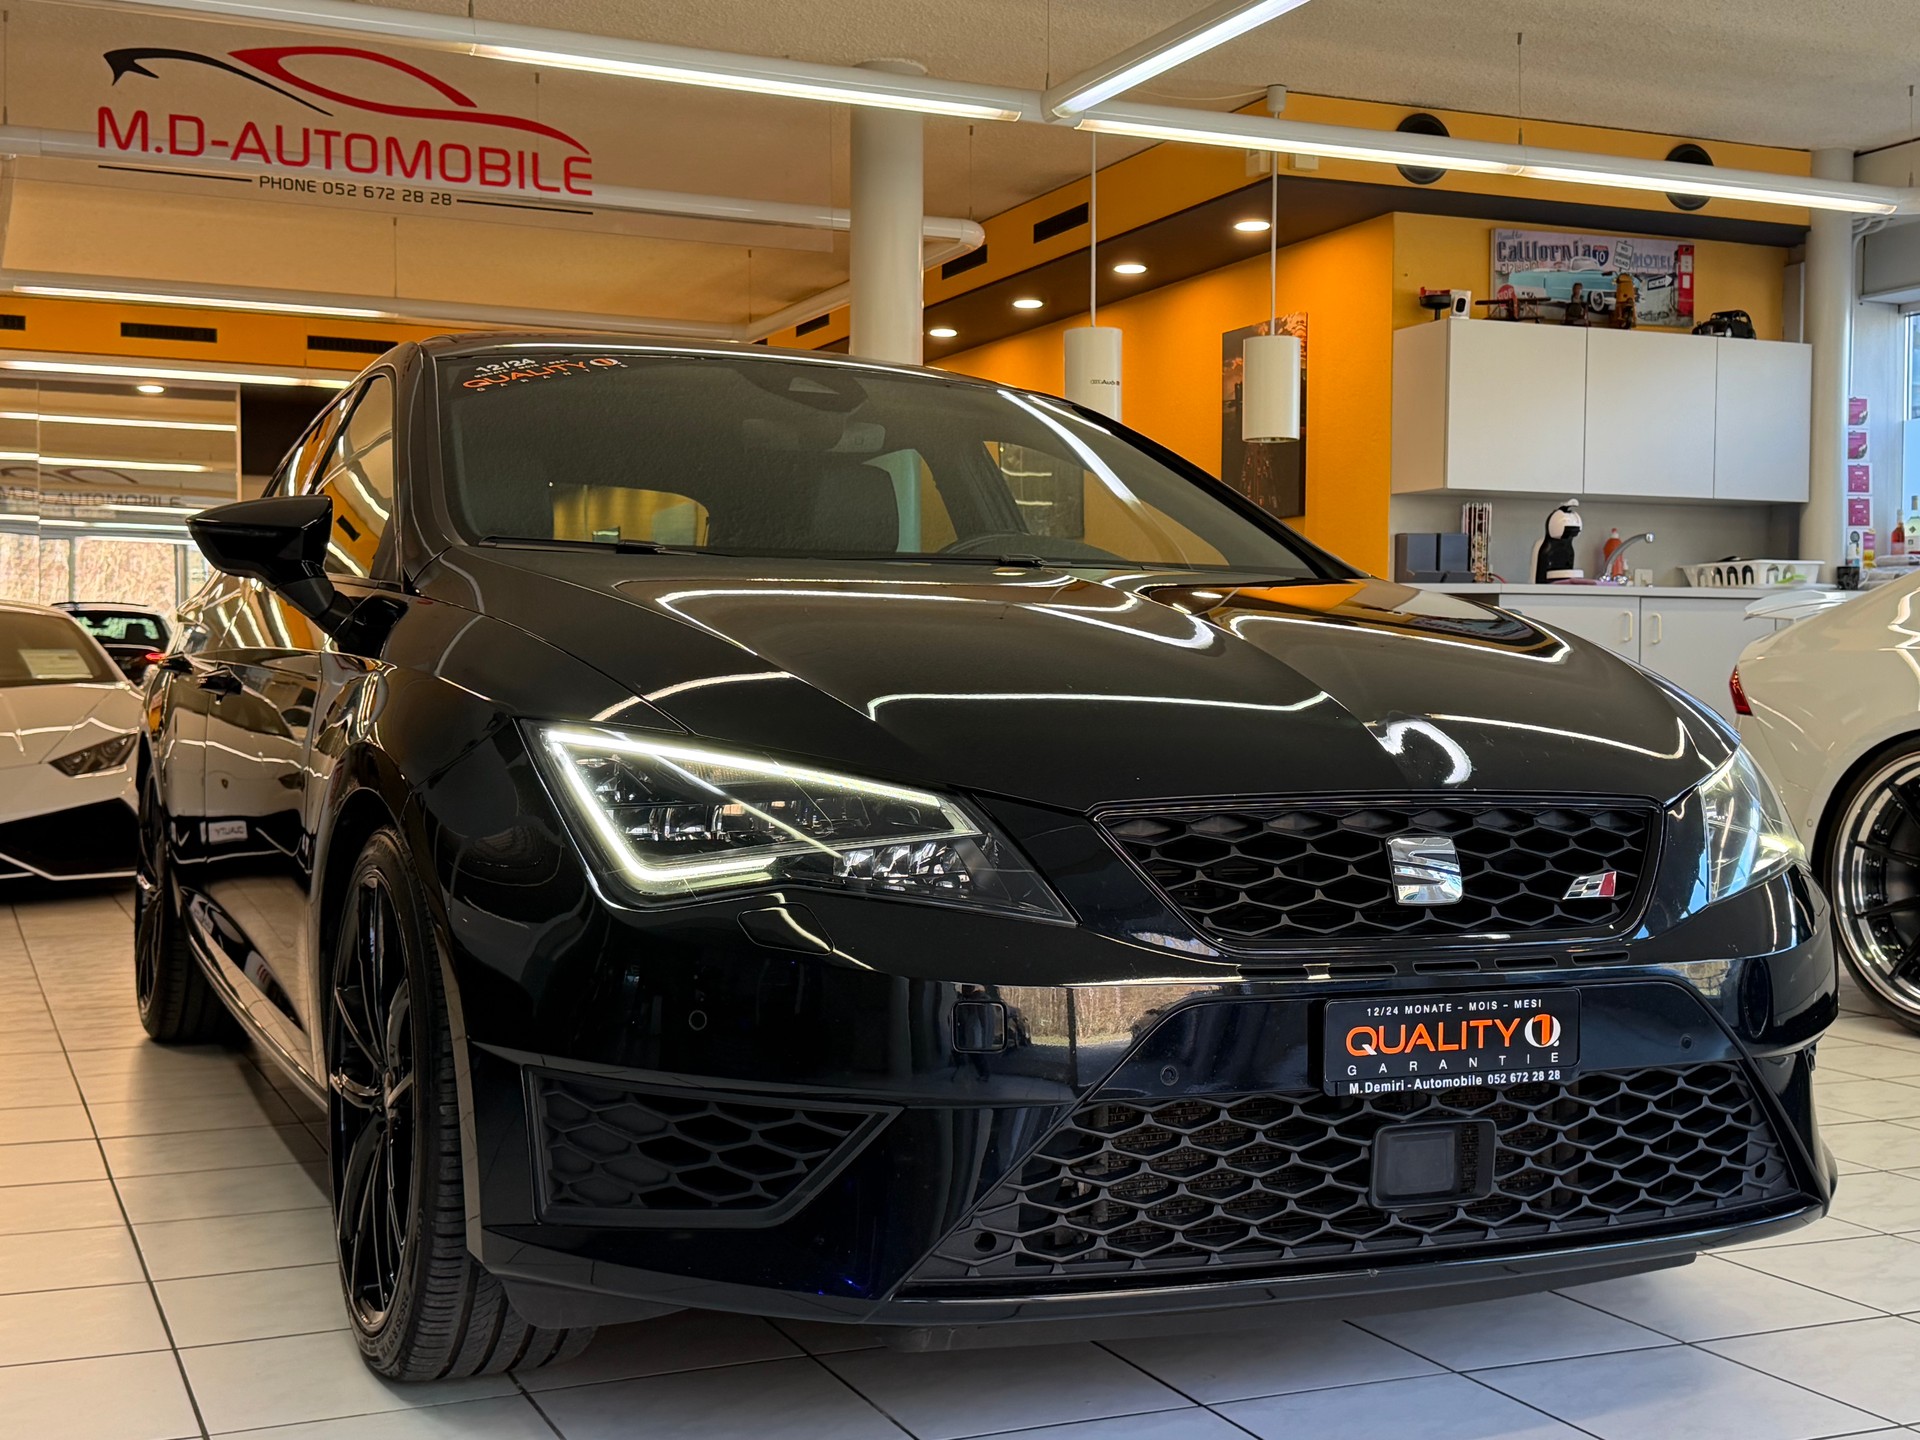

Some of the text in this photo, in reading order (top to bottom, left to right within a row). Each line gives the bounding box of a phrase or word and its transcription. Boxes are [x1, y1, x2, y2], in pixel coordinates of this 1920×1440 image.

[98, 106, 593, 196] M.D-AUTOMOBILE
[259, 175, 452, 206] PHONE 052 672 28 28
[1496, 239, 1592, 262] California
[1633, 252, 1674, 270] MOTEL
[463, 361, 587, 388] QUALITY
[476, 357, 536, 373] 12/24
[1366, 1006, 1399, 1017] 12/24
[1404, 1003, 1452, 1015] MONATE
[1468, 1001, 1498, 1012] MOIS
[1514, 999, 1542, 1010] MESI
[1345, 1017, 1521, 1057] QUALITY
[1347, 1052, 1559, 1076] GARANTIE
[1413, 1074, 1483, 1091] Automobile
[1487, 1073, 1507, 1085] 052
[1510, 1071, 1529, 1083] 672
[1532, 1070, 1545, 1082] 28
[1548, 1069, 1561, 1081] 28
